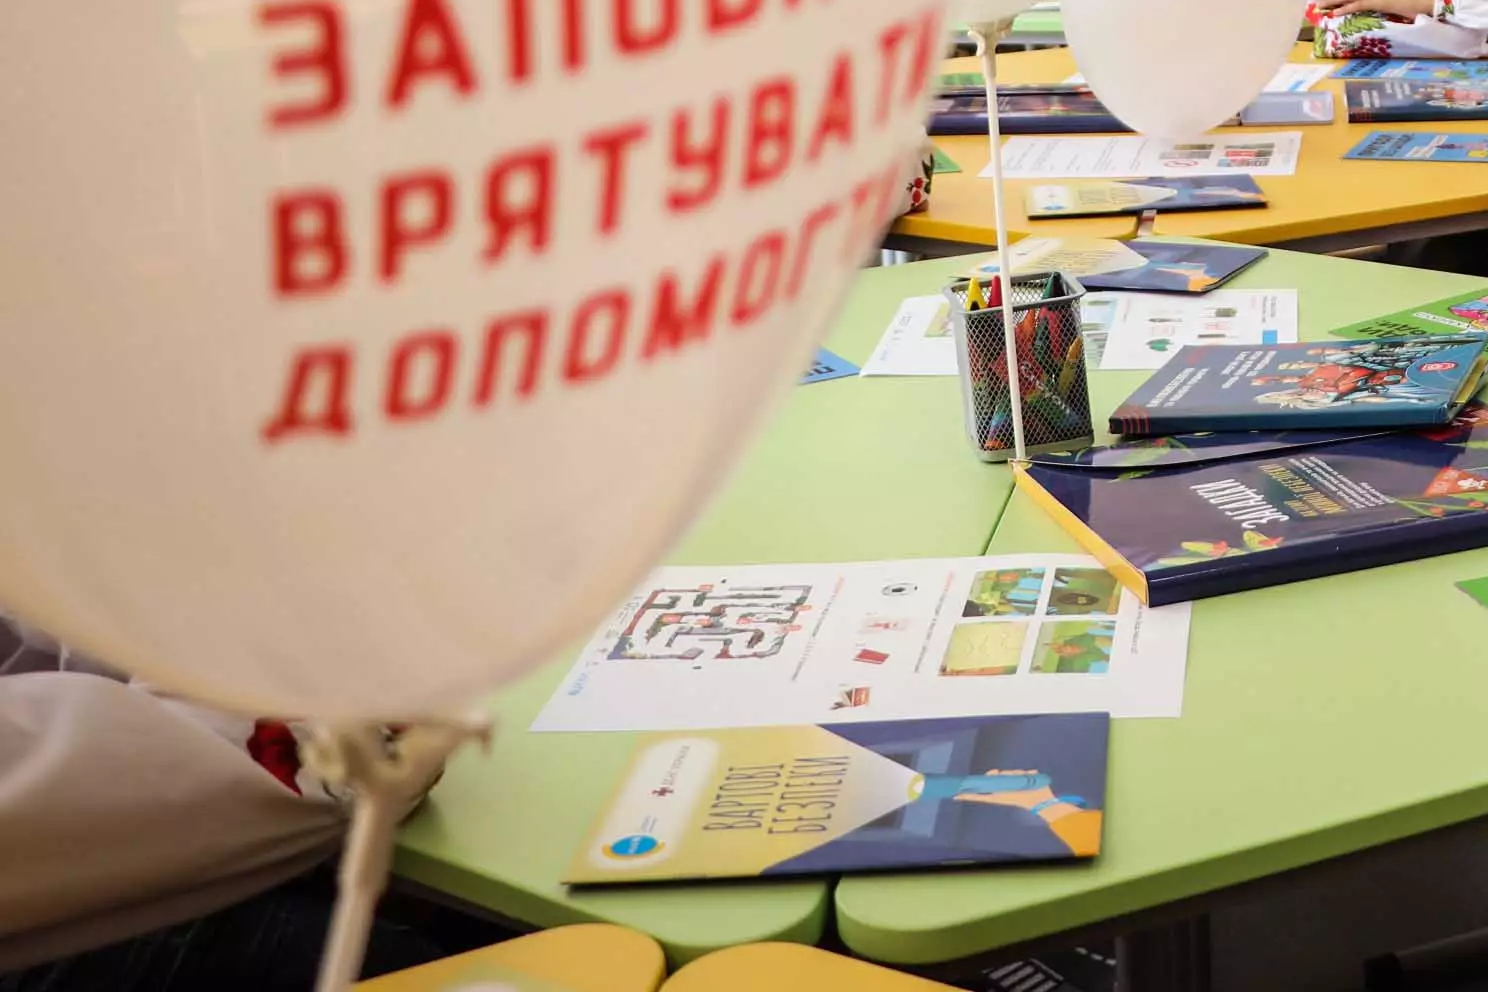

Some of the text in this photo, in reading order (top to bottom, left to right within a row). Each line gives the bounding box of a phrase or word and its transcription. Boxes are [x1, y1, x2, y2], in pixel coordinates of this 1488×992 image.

[270, 3, 940, 299] ВРЯТУВАТИ
[1188, 478, 1290, 529] ЗАГАДКИ
[701, 762, 787, 831] ВАРТОВІ
[765, 755, 852, 834] БЕЗПЕКИ
